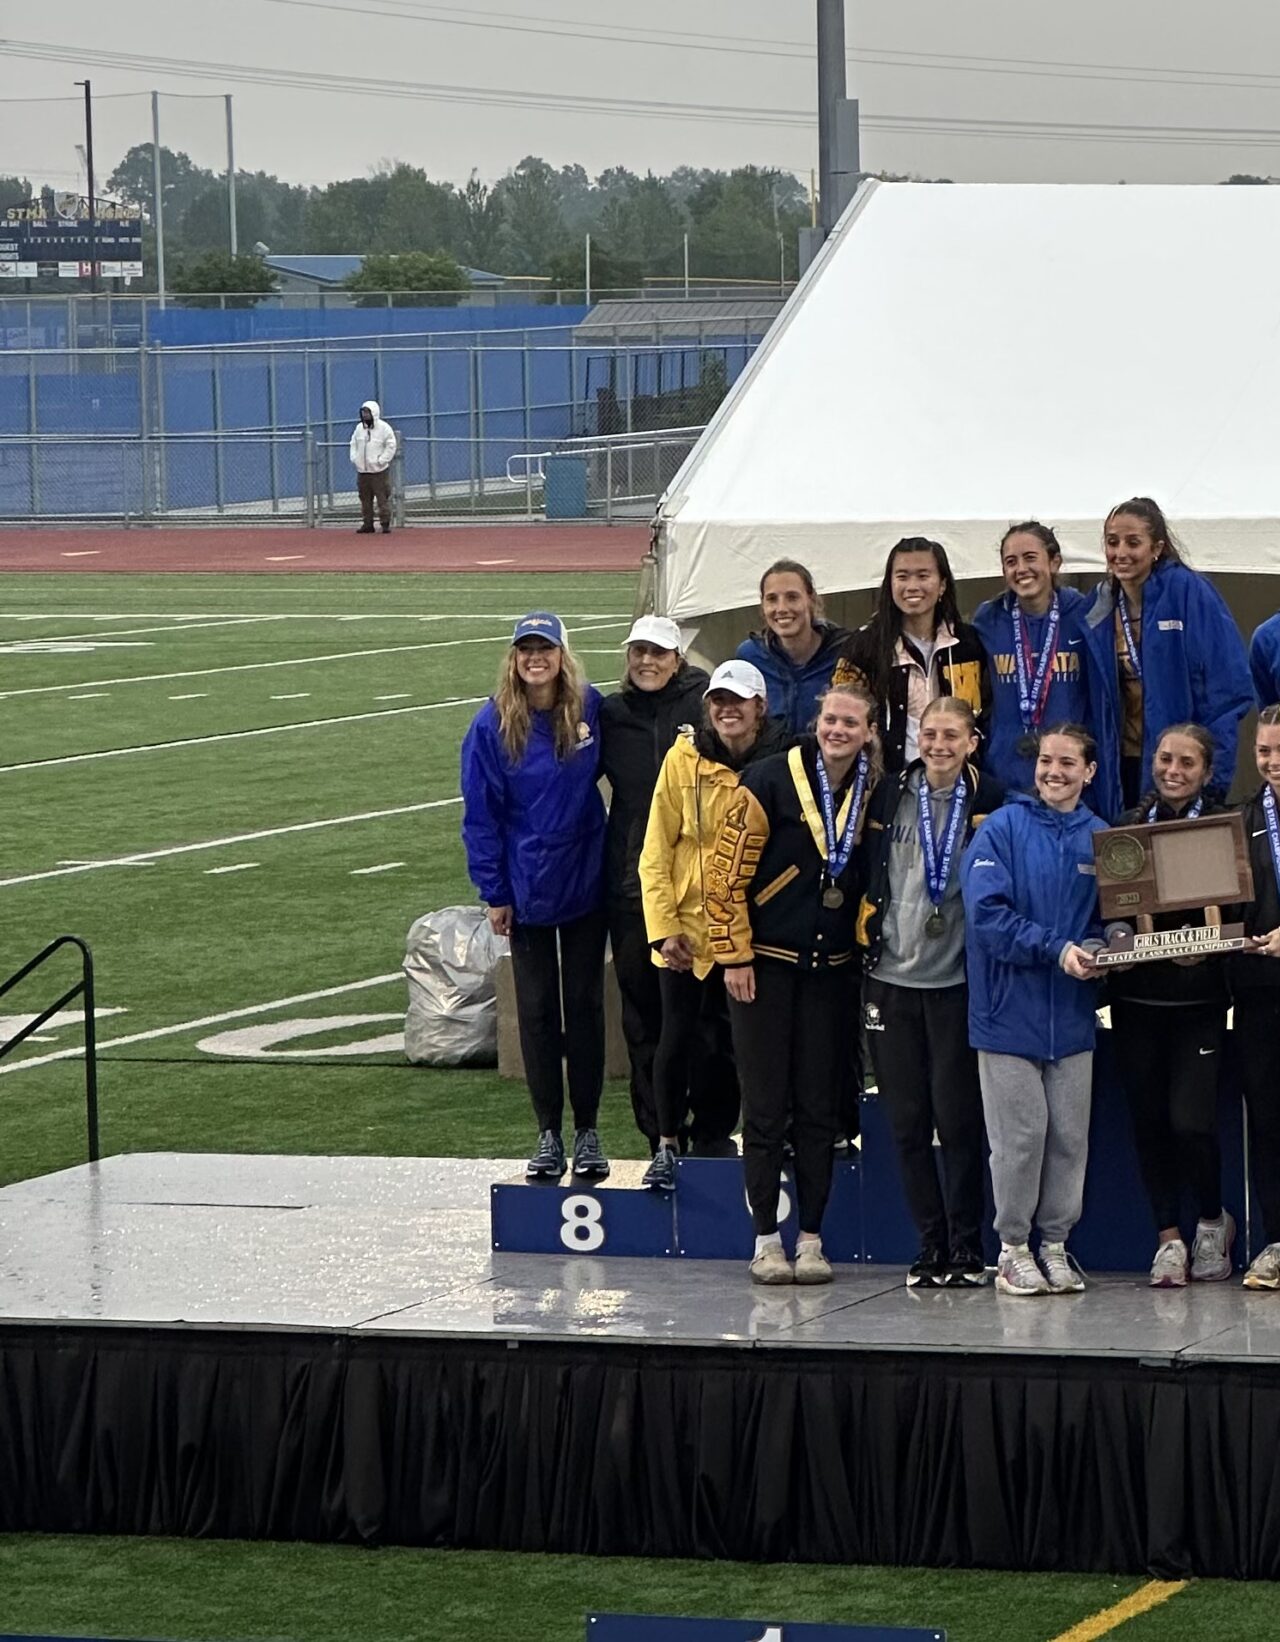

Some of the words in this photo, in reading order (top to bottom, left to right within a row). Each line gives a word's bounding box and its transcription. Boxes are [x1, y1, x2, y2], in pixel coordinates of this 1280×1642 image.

[7, 207, 48, 219] STMA
[1013, 620, 1022, 642] STATE
[1031, 679, 1043, 699] STATE
[818, 769, 830, 792] STATE
[1267, 808, 1278, 831] STATE
[842, 831, 854, 853] STATE
[940, 857, 951, 878] STATE
[1135, 935, 1159, 949] GIRLS
[1160, 931, 1187, 946] TRACK
[1187, 930, 1195, 943] &
[1195, 927, 1219, 942] FIELD
[1106, 952, 1134, 963] STATE
[1135, 949, 1165, 960] CLASS
[1184, 941, 1234, 954] CHAMPION
[560, 1195, 604, 1251] 8
